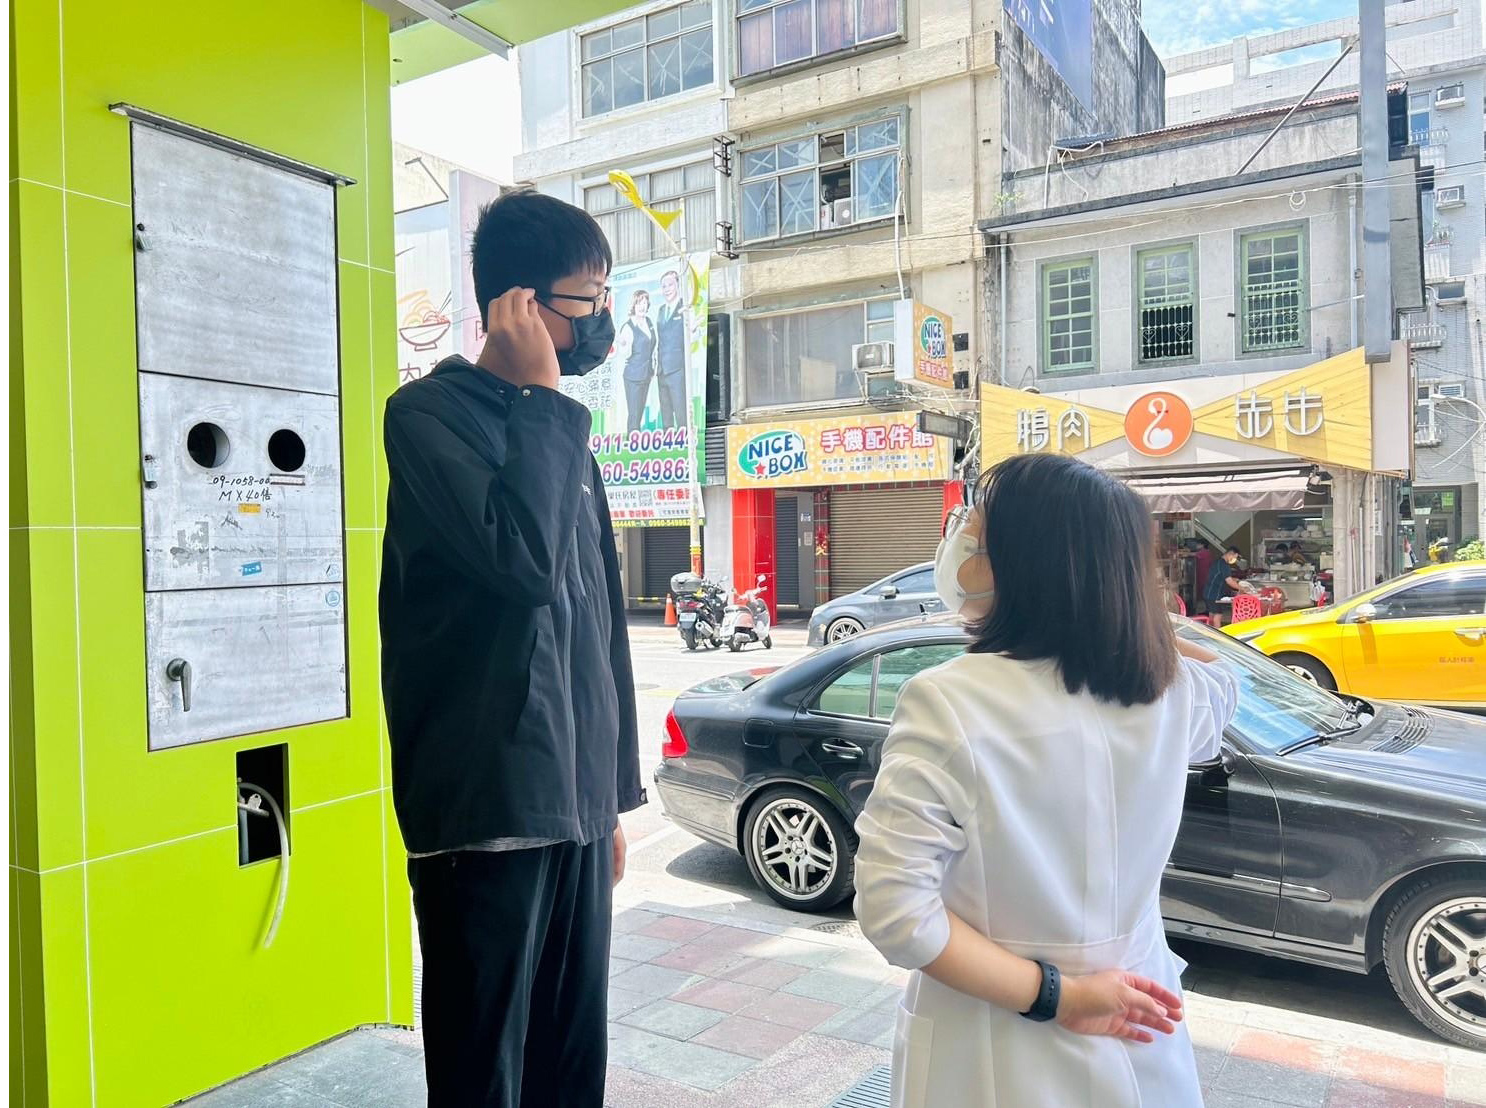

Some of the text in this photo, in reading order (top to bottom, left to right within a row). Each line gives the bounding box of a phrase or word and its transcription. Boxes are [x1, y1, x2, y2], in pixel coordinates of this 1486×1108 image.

[924, 323, 942, 339] NICE
[590, 428, 691, 455] 911-80644
[748, 434, 794, 460] NICE
[768, 451, 805, 475] BOX
